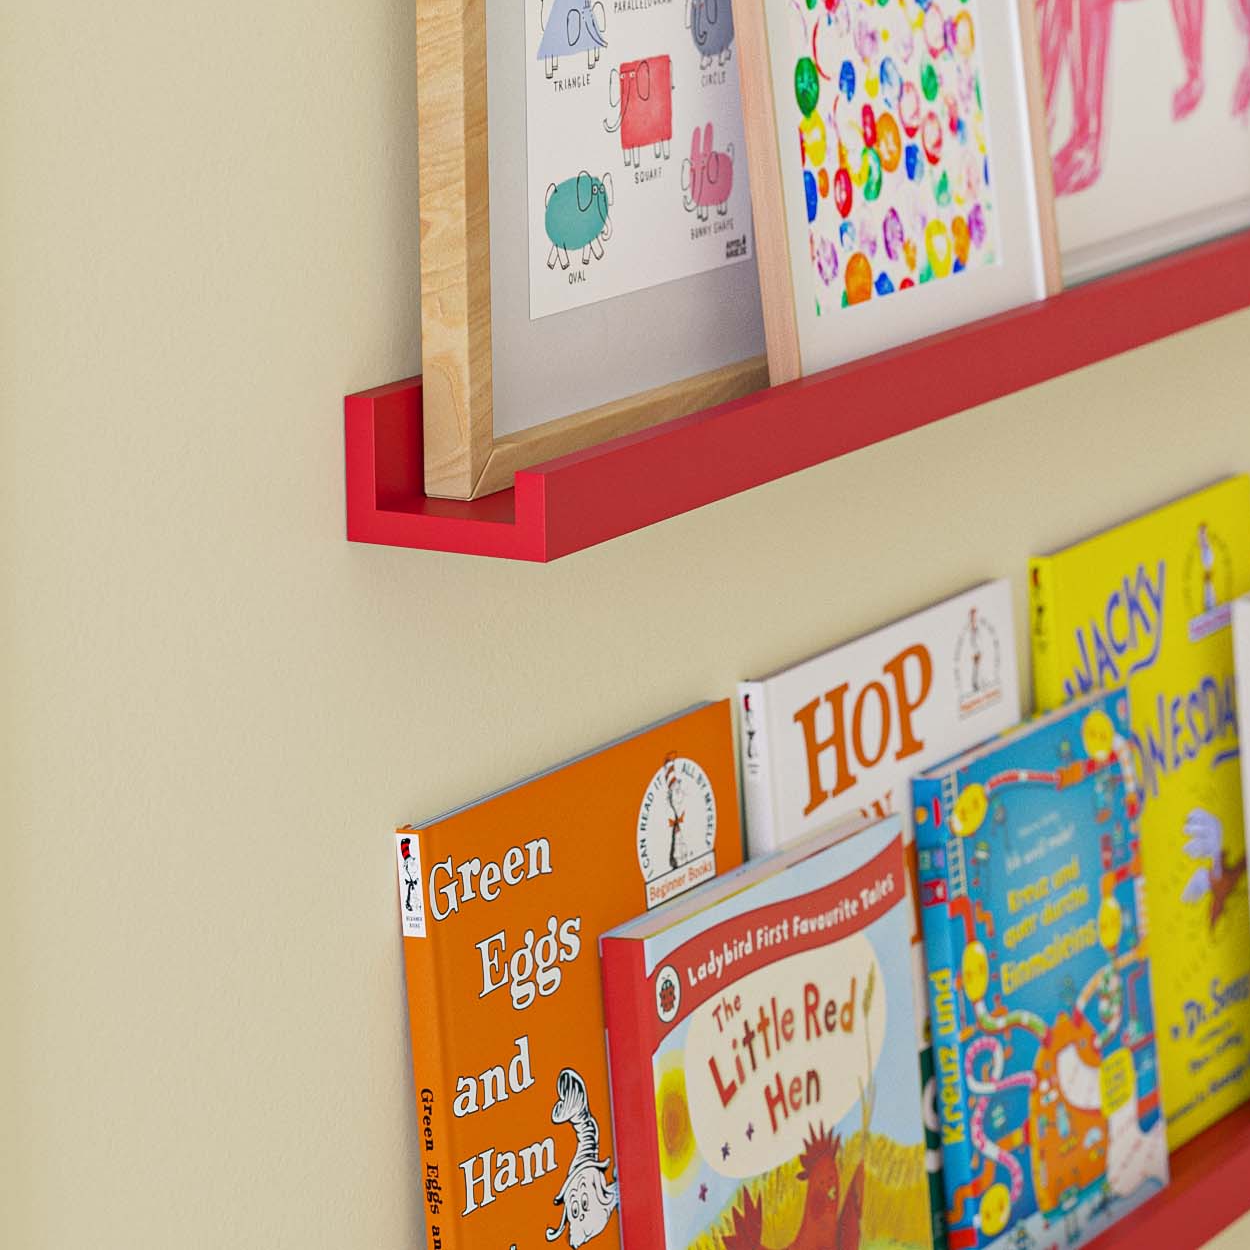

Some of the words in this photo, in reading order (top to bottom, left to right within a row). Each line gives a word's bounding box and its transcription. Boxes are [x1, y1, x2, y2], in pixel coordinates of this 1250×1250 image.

[553, 73, 591, 92] TRIANGLE
[701, 71, 726, 88] CIRCLE
[568, 270, 586, 285] OVAL
[1064, 558, 1167, 696] WACKY
[794, 643, 933, 817] HOP
[653, 774, 663, 790] IT
[681, 761, 696, 779] ALL
[640, 792, 655, 832] READ
[704, 792, 714, 847] MYSELF
[428, 836, 553, 922] Green
[640, 837, 650, 869] CAN
[649, 874, 687, 901] Beginner
[687, 861, 713, 883] Books
[1008, 876, 1049, 914] Kreuz
[1051, 854, 1081, 890] und
[687, 935, 753, 987] Ladybird
[756, 921, 789, 950] First
[792, 901, 858, 938] Favourite
[860, 872, 895, 911] Tales
[1003, 913, 1039, 949] quer
[1041, 884, 1089, 926] durchs
[475, 914, 582, 1011] Eggs
[1001, 919, 1098, 996] Einmaleins
[712, 994, 742, 1033] The
[929, 967, 956, 1036] und
[708, 997, 795, 1108] Little
[804, 975, 857, 1042] Red
[452, 1034, 536, 1118] and
[764, 1070, 821, 1134] Hen
[937, 1046, 965, 1145] Kreuz
[419, 1088, 435, 1151] Green
[425, 1163, 443, 1215] Eggs
[457, 1137, 558, 1218] Ham
